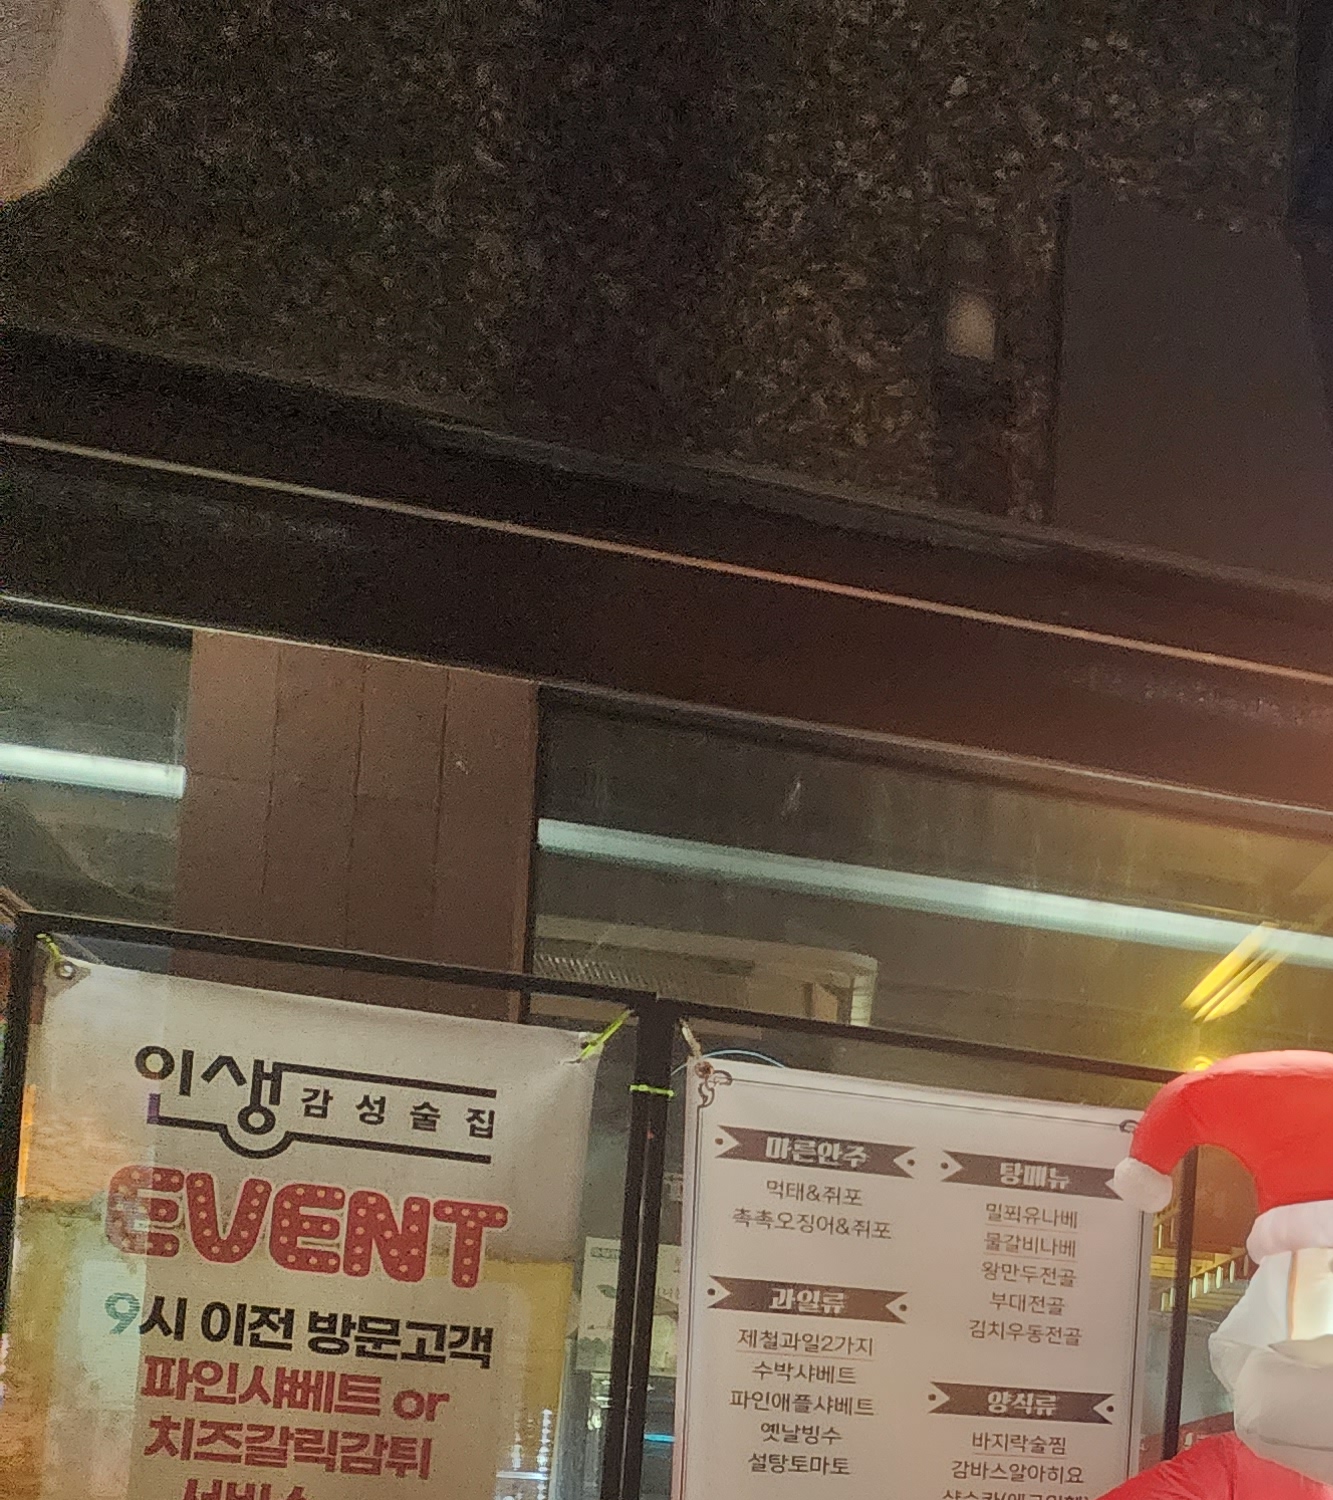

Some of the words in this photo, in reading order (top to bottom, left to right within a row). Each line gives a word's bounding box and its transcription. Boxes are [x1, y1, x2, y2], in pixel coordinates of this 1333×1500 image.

[134, 1044, 283, 1137] 인생
[301, 1086, 497, 1140] 감성술집
[765, 1136, 869, 1168] 마른안주
[999, 1161, 1071, 1190] 탕메뉴
[765, 1178, 863, 1206] 먹태&쥐포
[106, 1164, 510, 1288] EVENT
[732, 1207, 892, 1240] 촉촉오징어&쥐포
[984, 1232, 1077, 1258] 물갈비나베
[981, 1261, 1077, 1287] 왕만두전골
[768, 1287, 846, 1315] 과일류
[989, 1291, 1066, 1316] 부대전골
[104, 1292, 186, 1341] 9시
[202, 1300, 295, 1351] 이전
[308, 1312, 495, 1368] 방문고객
[737, 1328, 874, 1357] 제철과일2가지
[969, 1318, 1083, 1346] 김치우동전골
[752, 1361, 857, 1386] 수박샤베트
[141, 1355, 382, 1418] 파인샤베트
[392, 1392, 450, 1422] or
[729, 1390, 875, 1418] 파인애플샤베트
[987, 1391, 1058, 1417] 양식류
[760, 1421, 842, 1446] 옛날빙수
[971, 1431, 1067, 1455] 바지락술찜
[143, 1416, 432, 1480] 치즈갈릭감튀
[748, 1450, 852, 1476] 설탕토마토
[951, 1460, 1084, 1485] 감바스알아히요
